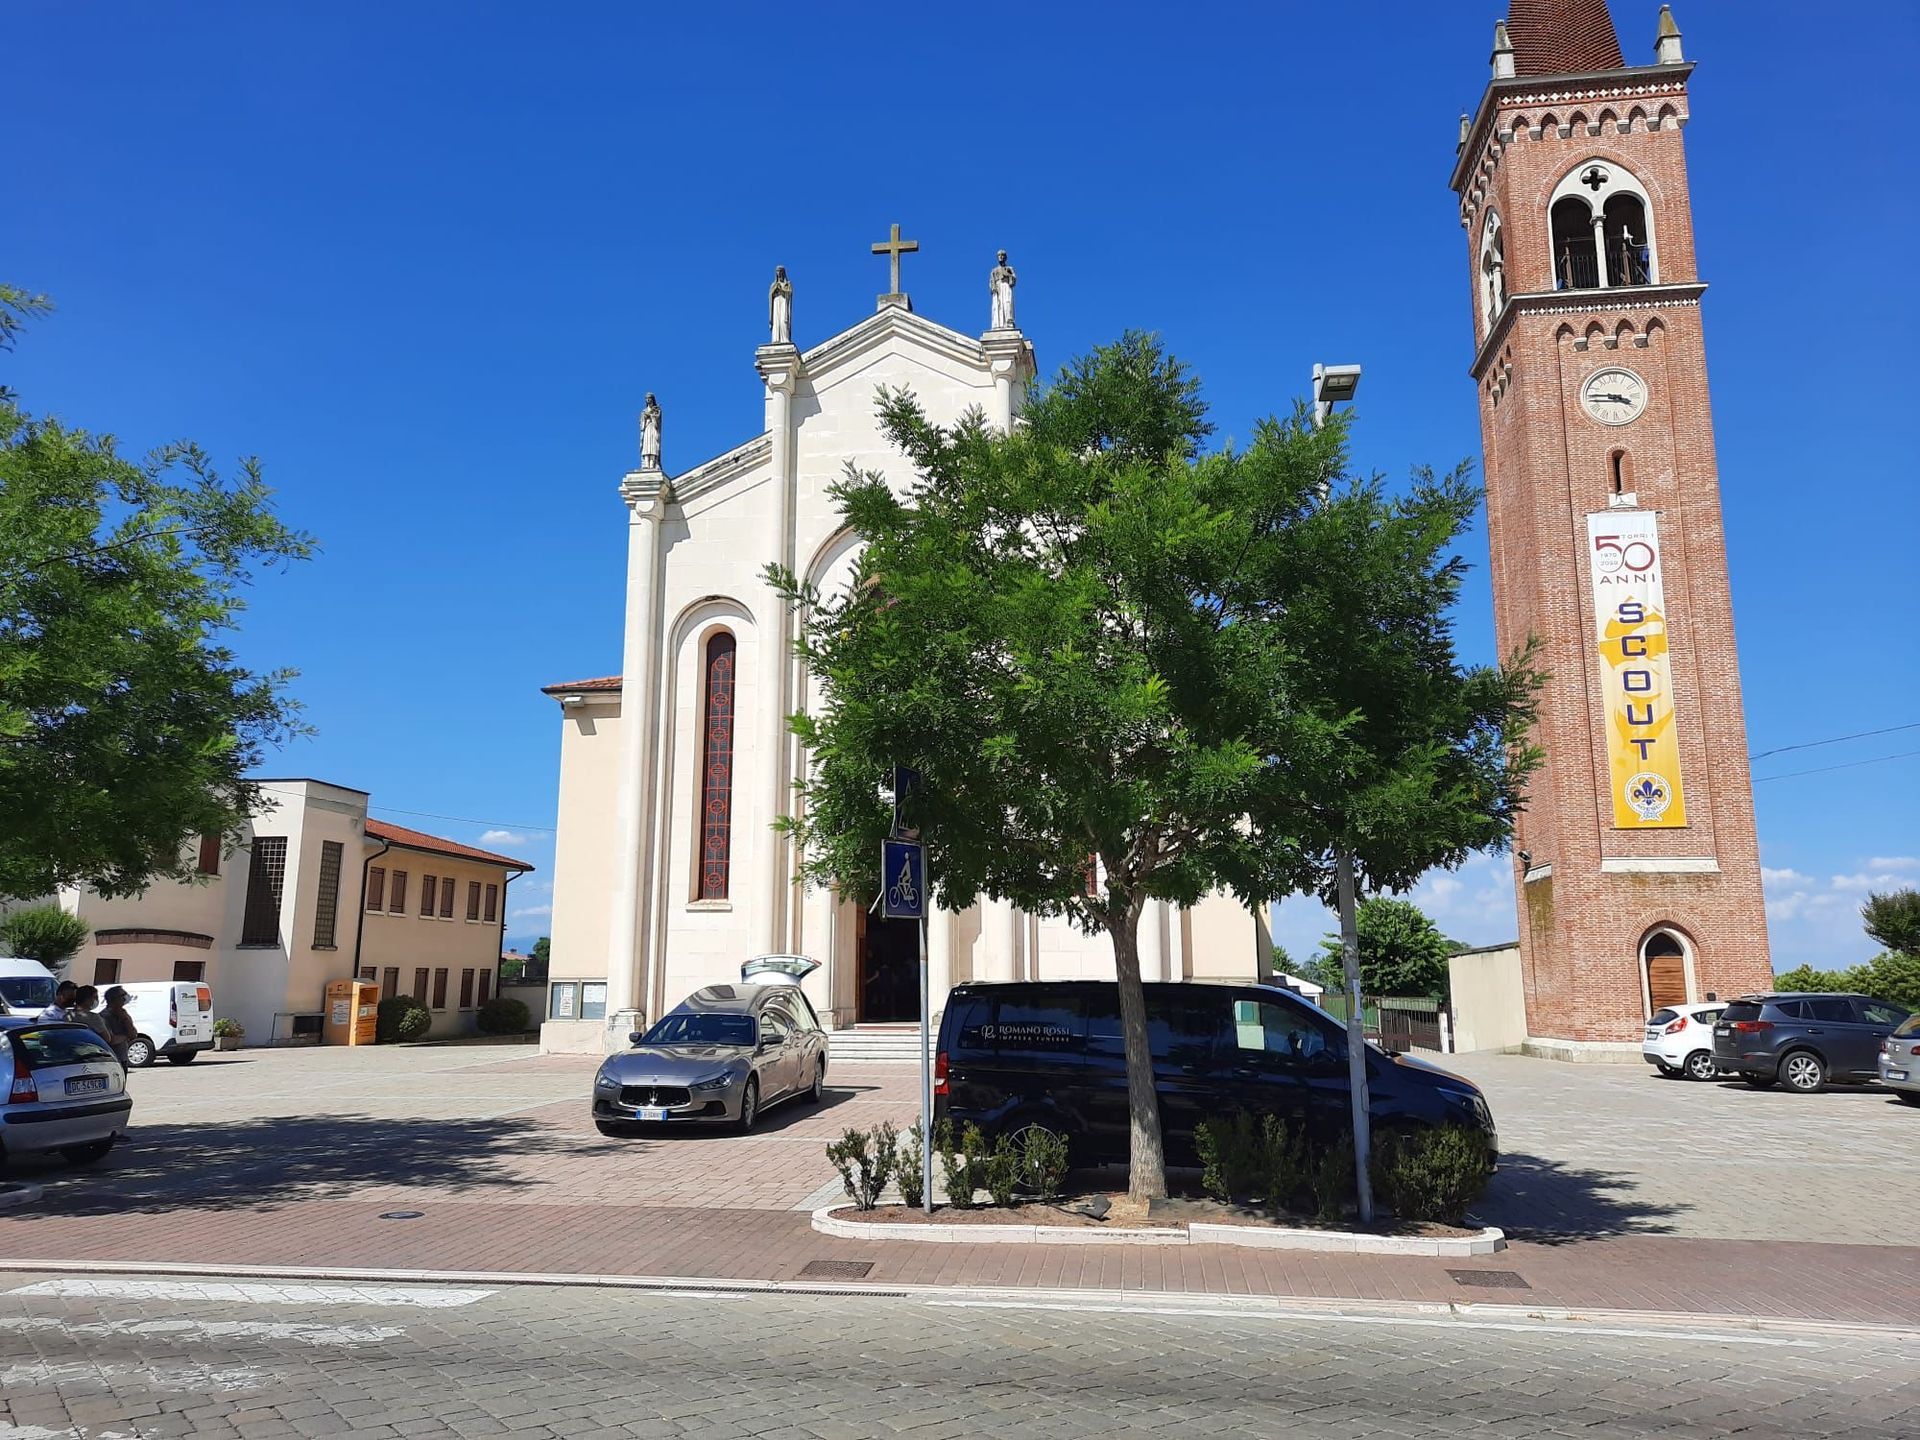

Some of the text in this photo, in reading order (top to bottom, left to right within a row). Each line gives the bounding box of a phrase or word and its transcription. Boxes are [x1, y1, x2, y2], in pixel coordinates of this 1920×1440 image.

[1595, 535, 1655, 573] 50
[1600, 573, 1656, 585] ANNI
[1618, 602, 1656, 761] SCOUT
[999, 1025, 1070, 1036] ROMANO ROSSI
